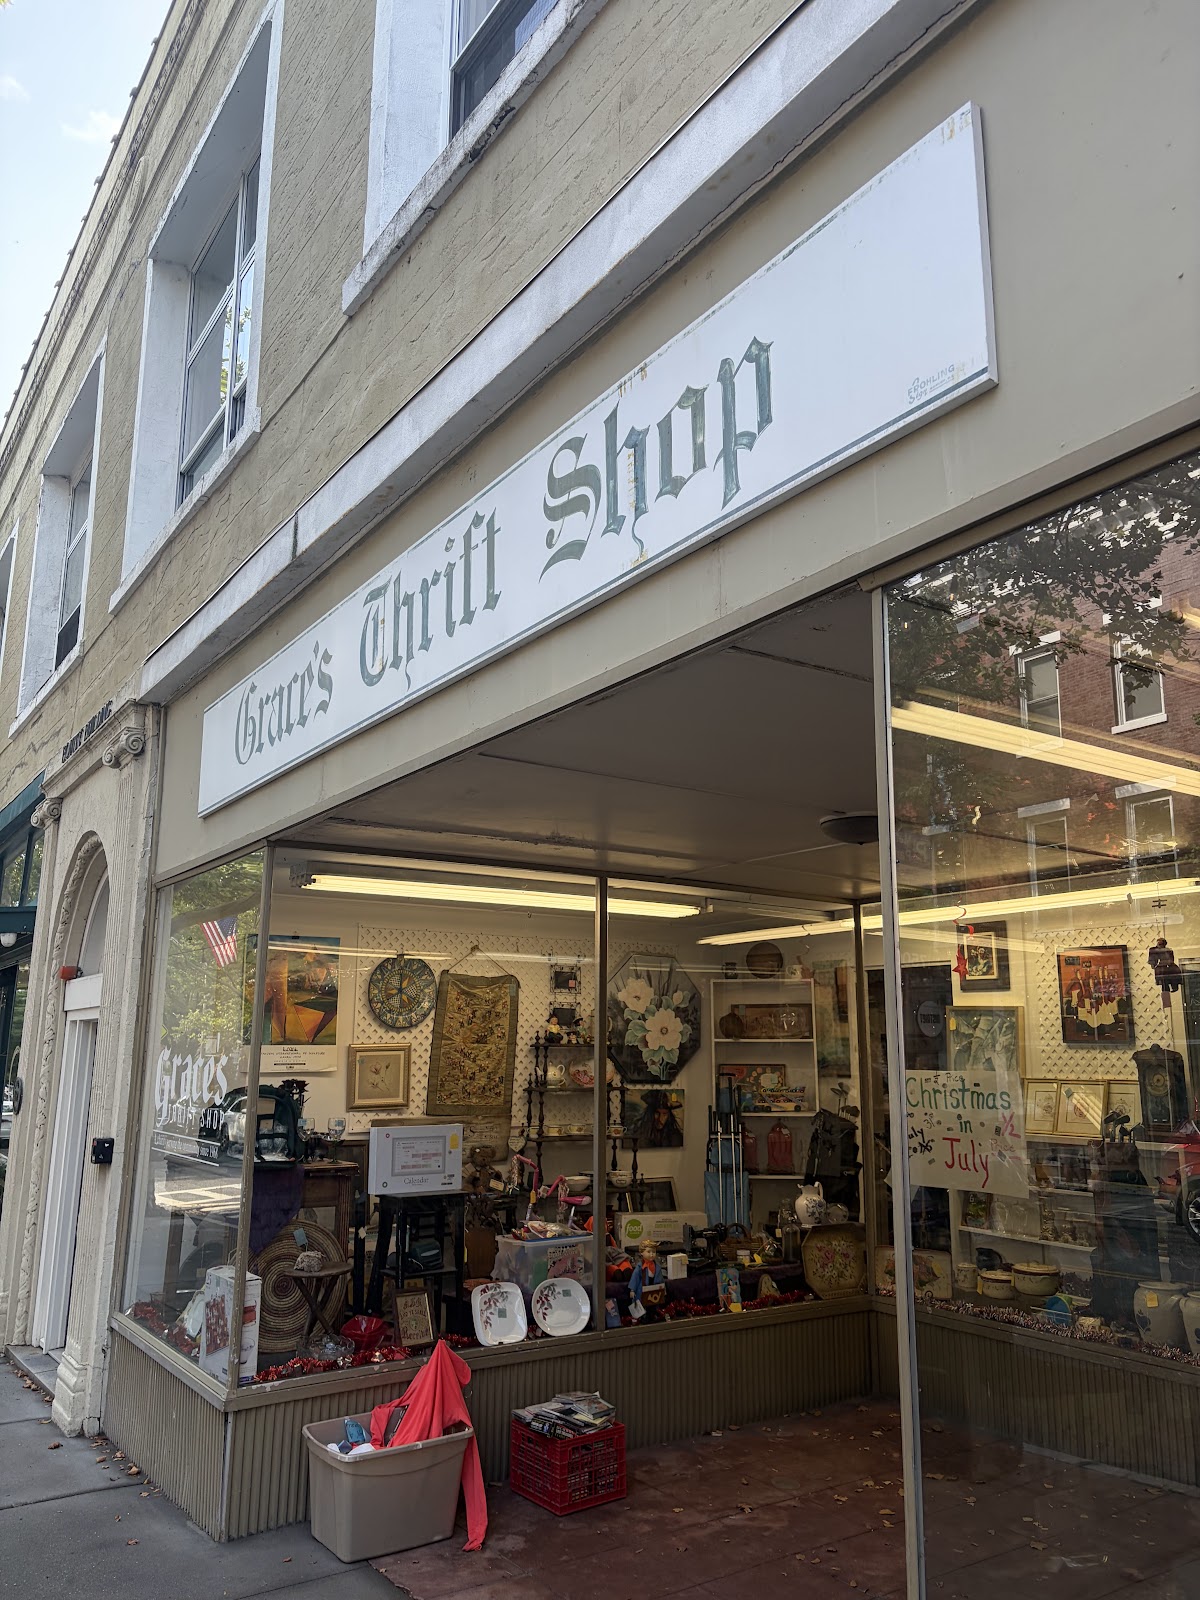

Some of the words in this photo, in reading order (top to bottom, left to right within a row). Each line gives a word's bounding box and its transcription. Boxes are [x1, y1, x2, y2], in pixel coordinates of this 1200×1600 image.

[907, 364, 955, 397] FROHLING
[234, 640, 333, 765] Grace's
[359, 507, 502, 692] Thrift
[539, 336, 775, 583] Shop
[155, 1046, 228, 1126] Graces
[905, 1077, 1011, 1110] Christmas
[200, 1109, 225, 1131] SHOP
[959, 1113, 972, 1133] in
[907, 1126, 926, 1144] uly
[942, 1137, 989, 1188] July
[403, 1176, 429, 1185] Calendar
[625, 1223, 643, 1237] food
